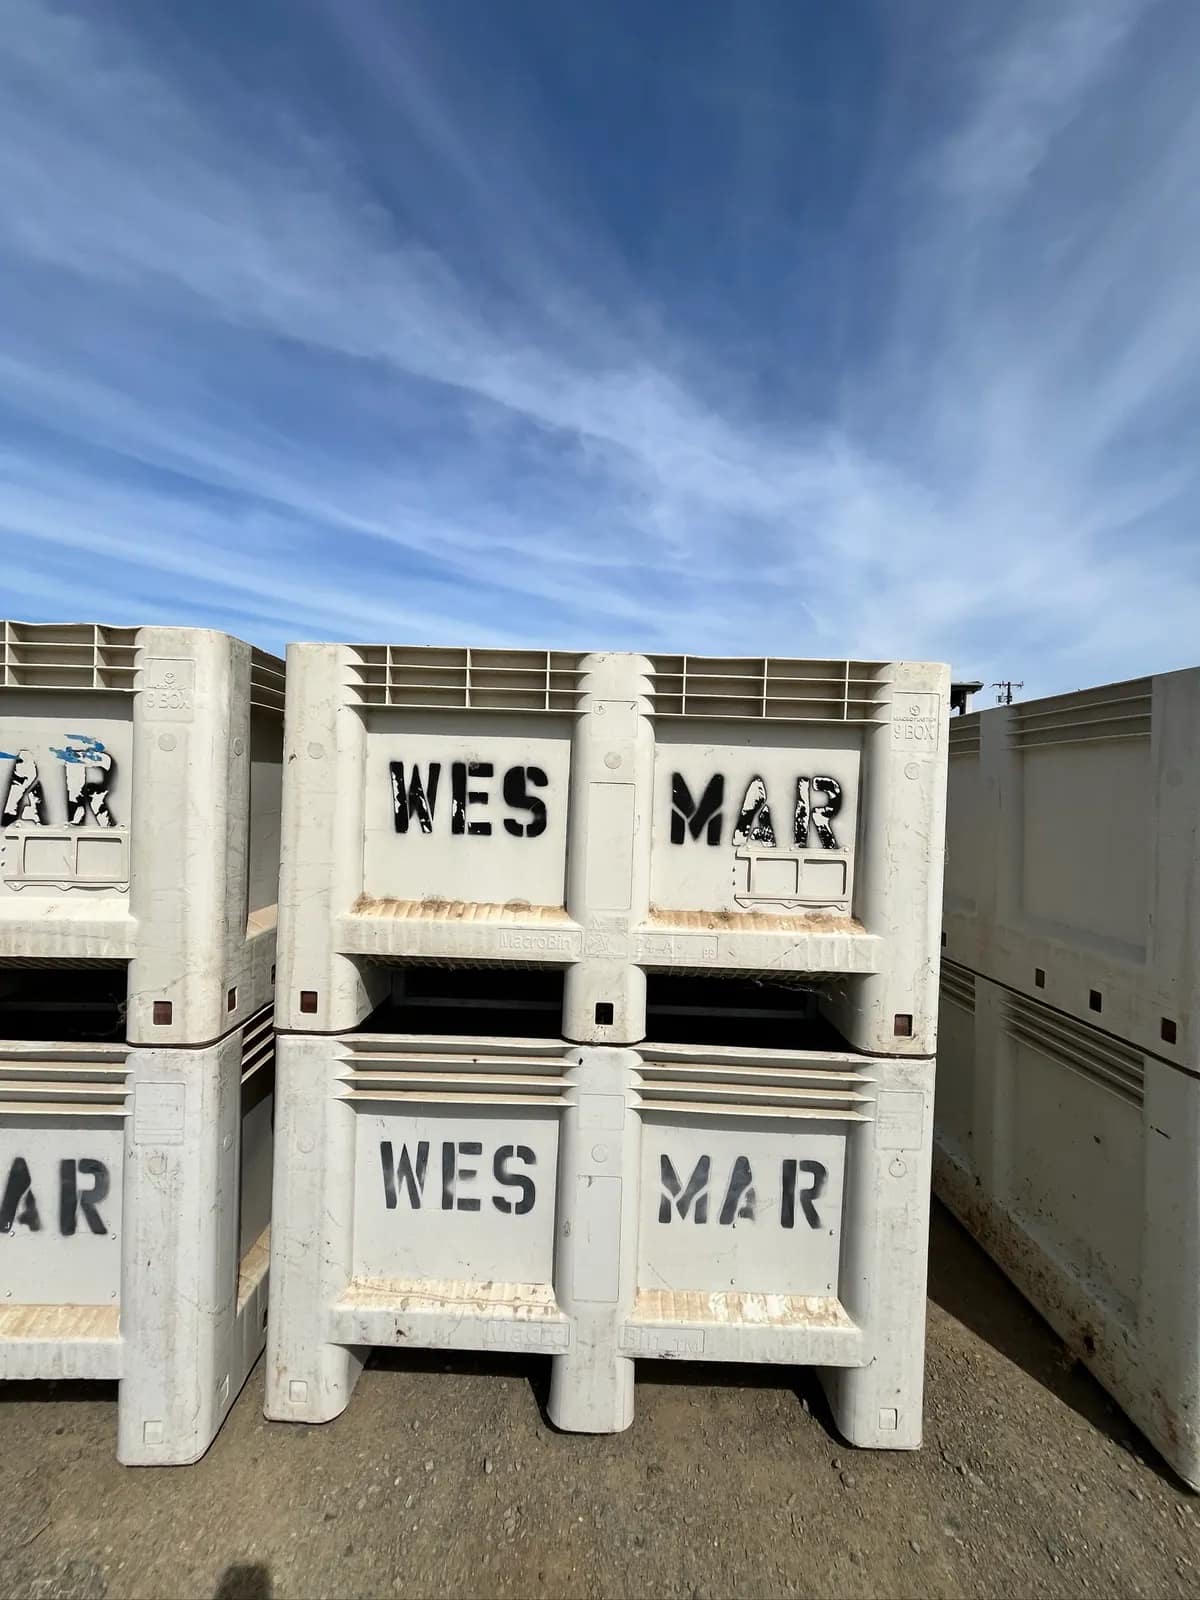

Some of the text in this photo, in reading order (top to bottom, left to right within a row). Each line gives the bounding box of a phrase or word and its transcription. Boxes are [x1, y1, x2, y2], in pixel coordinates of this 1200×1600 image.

[389, 760, 843, 850] WES MAR
[0, 1156, 111, 1237] AR
[380, 1141, 829, 1230] WES MAR
